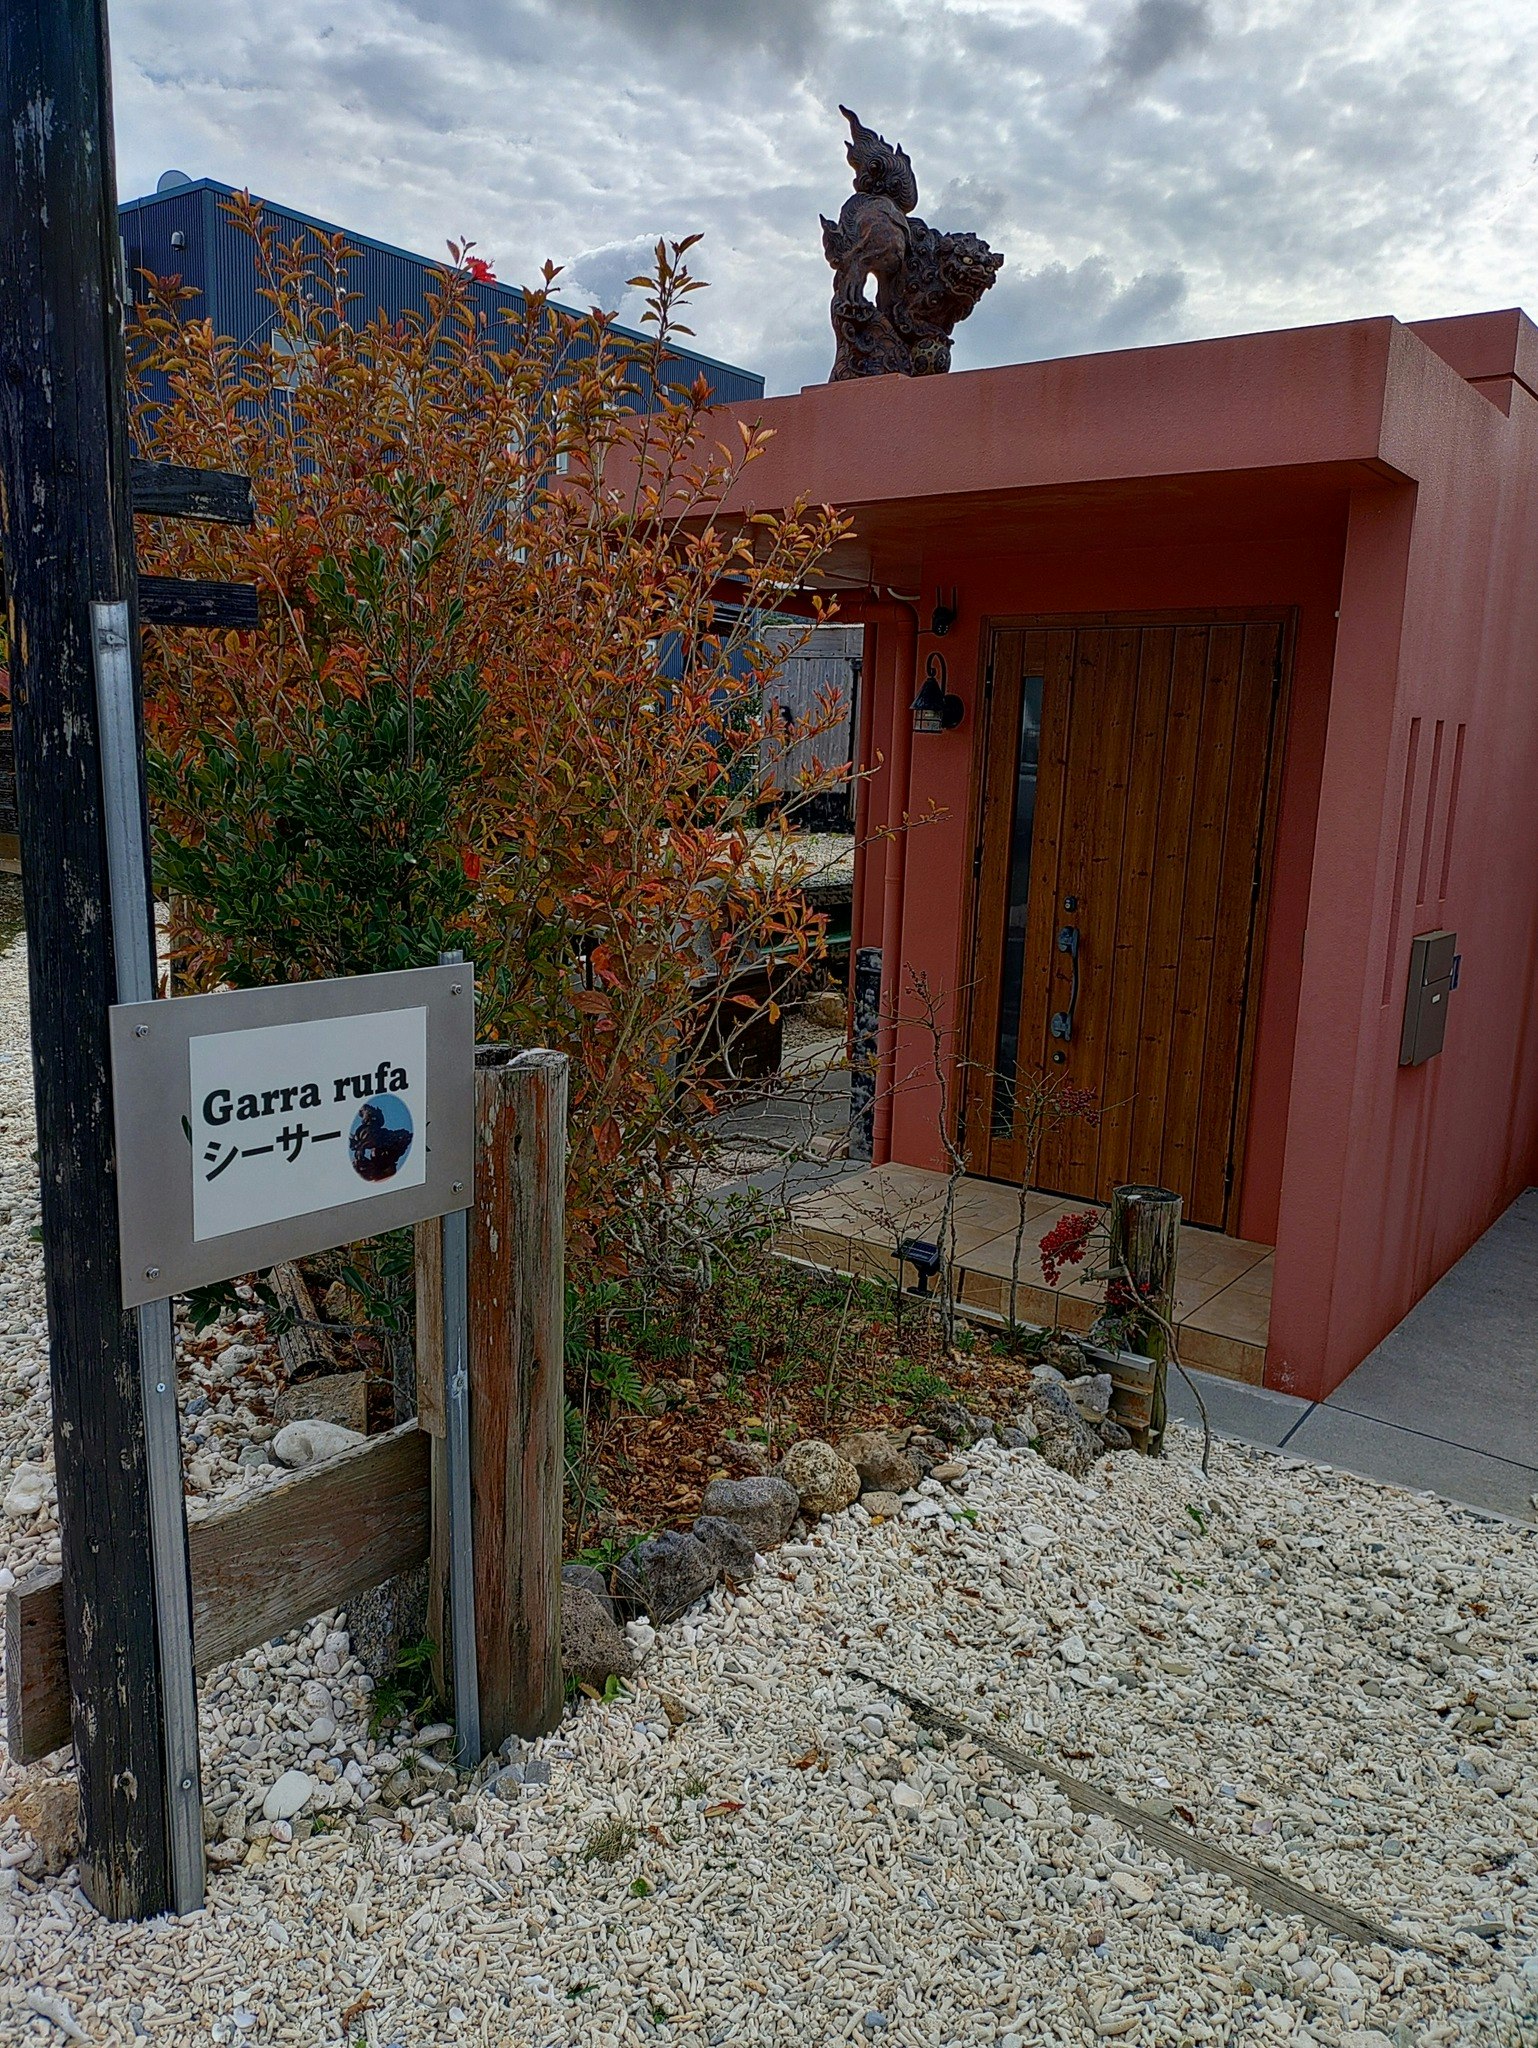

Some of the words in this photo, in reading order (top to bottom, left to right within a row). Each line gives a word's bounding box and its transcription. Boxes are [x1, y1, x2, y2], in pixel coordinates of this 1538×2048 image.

[202, 1082, 321, 1126] Garra
[333, 1061, 409, 1102] rufa
[203, 1123, 341, 1182] シーサー
